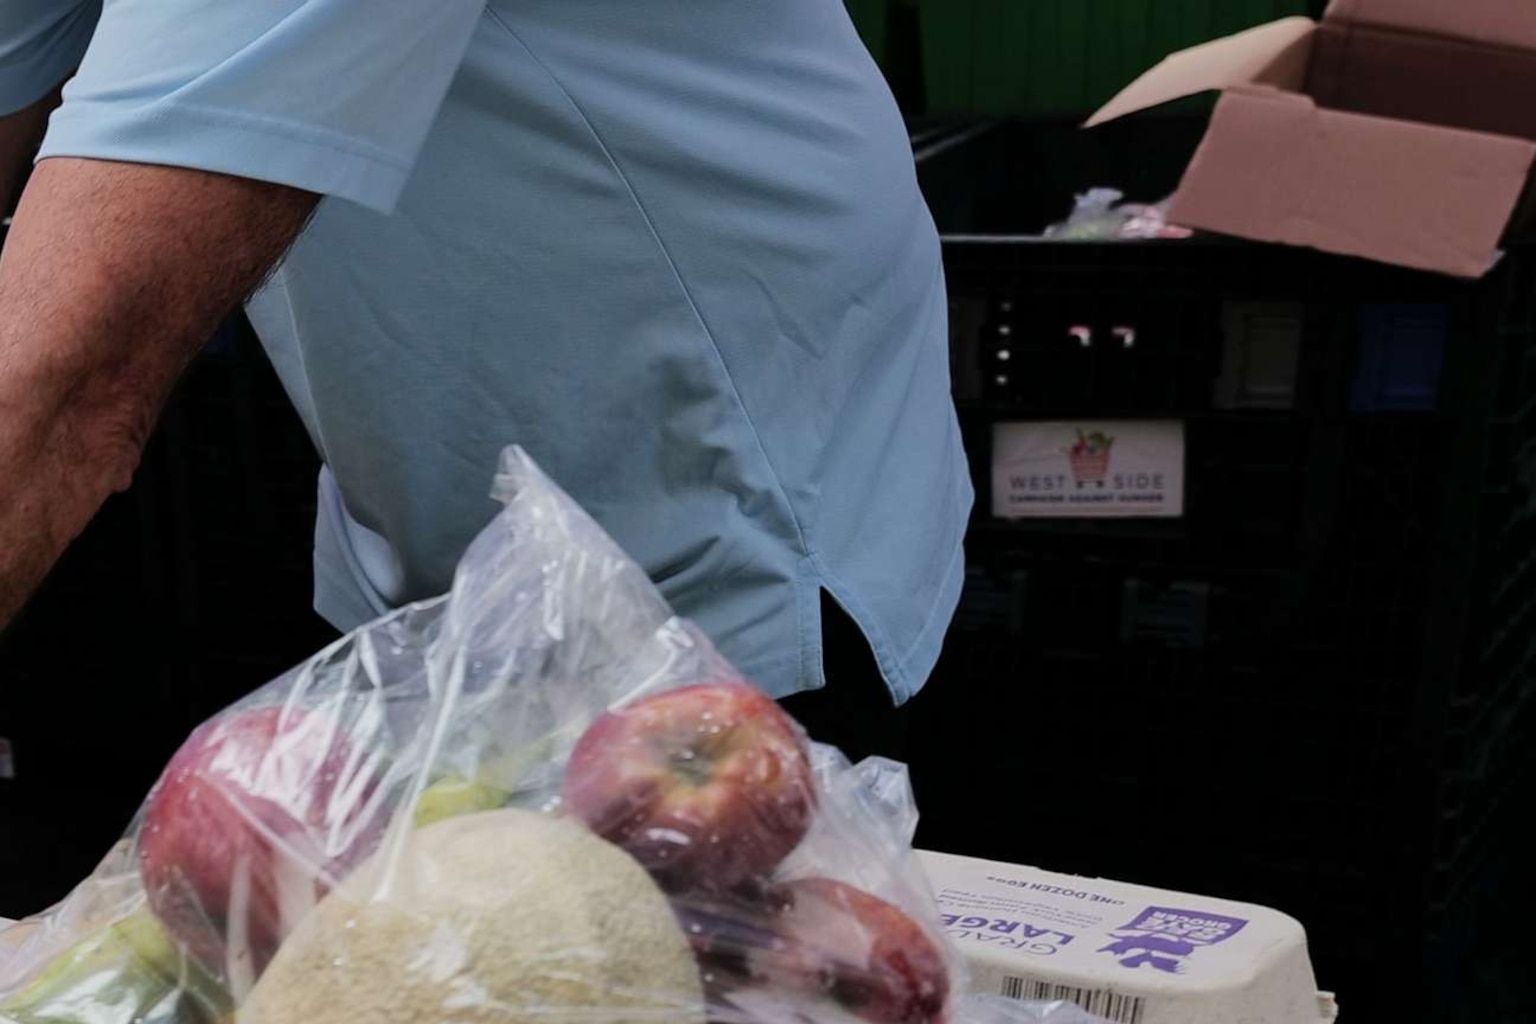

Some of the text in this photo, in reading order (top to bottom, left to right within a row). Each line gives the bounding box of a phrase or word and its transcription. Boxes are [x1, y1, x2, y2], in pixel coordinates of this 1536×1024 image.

[1010, 473, 1163, 490] WEST SIDE
[1029, 882, 1087, 900] DOZEN
[940, 913, 1076, 946] LARGE
[1151, 911, 1232, 930] GROCER
[944, 928, 1057, 956] GRAD
